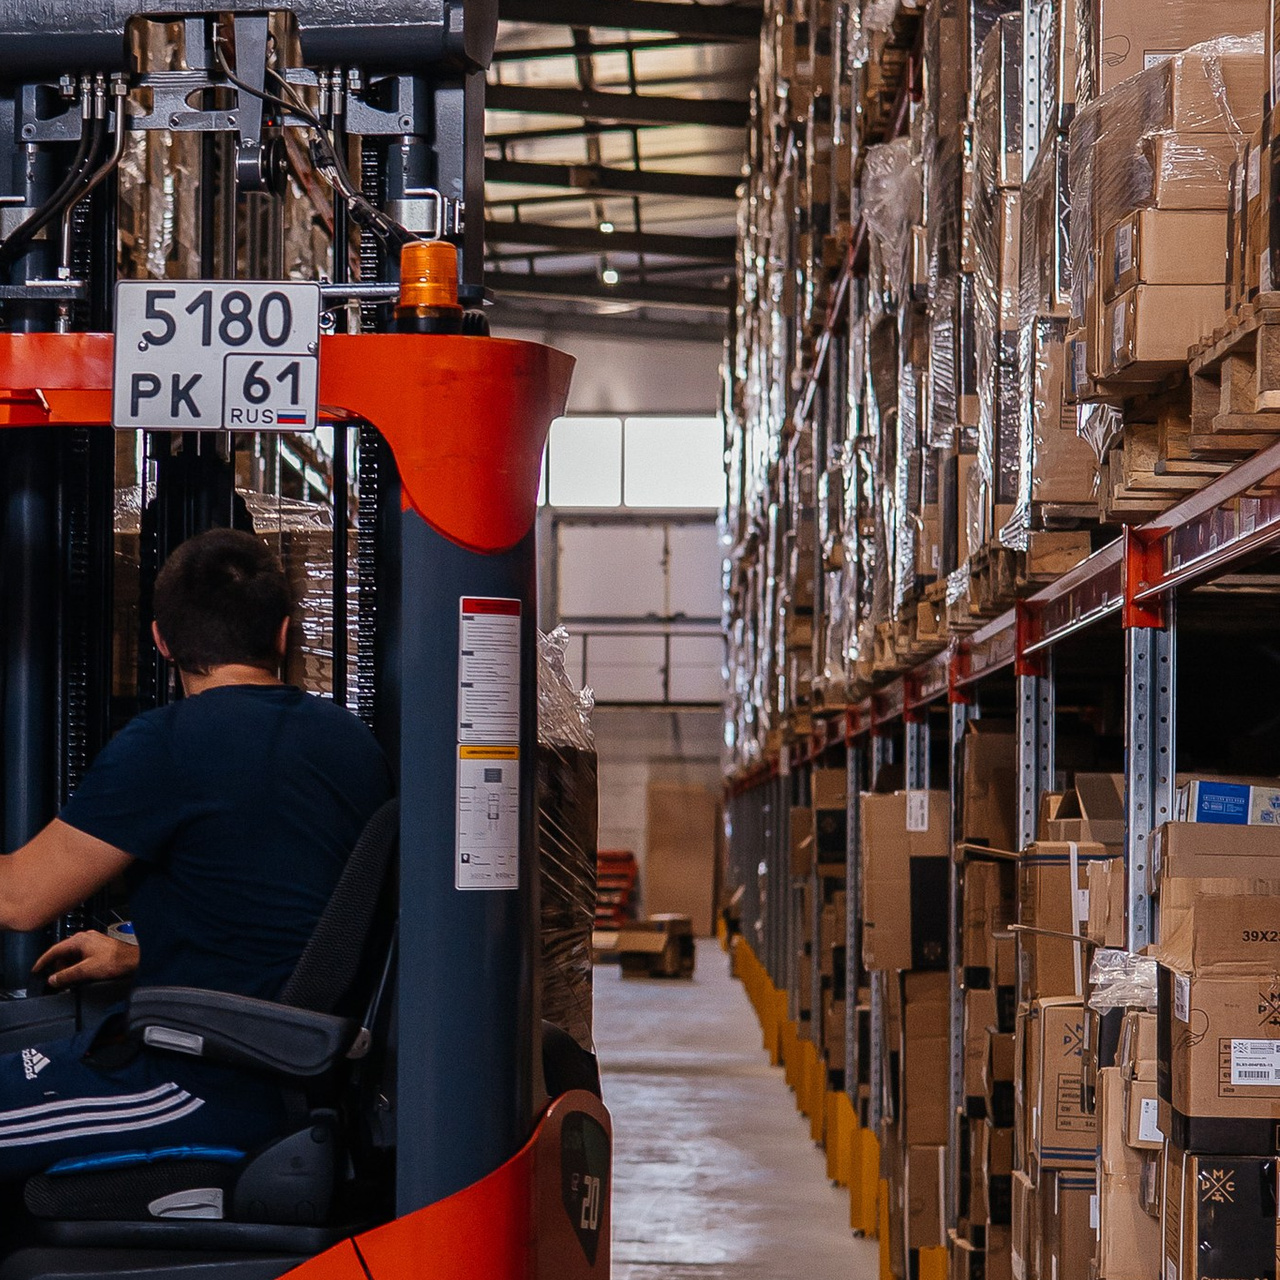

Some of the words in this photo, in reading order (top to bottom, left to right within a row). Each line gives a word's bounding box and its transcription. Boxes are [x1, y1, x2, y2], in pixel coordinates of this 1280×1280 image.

[142, 290, 292, 348] 5180
[131, 373, 202, 418] PK
[243, 360, 300, 405] 61
[231, 408, 274, 424] RUS
[1242, 930, 1280, 942] 39X2
